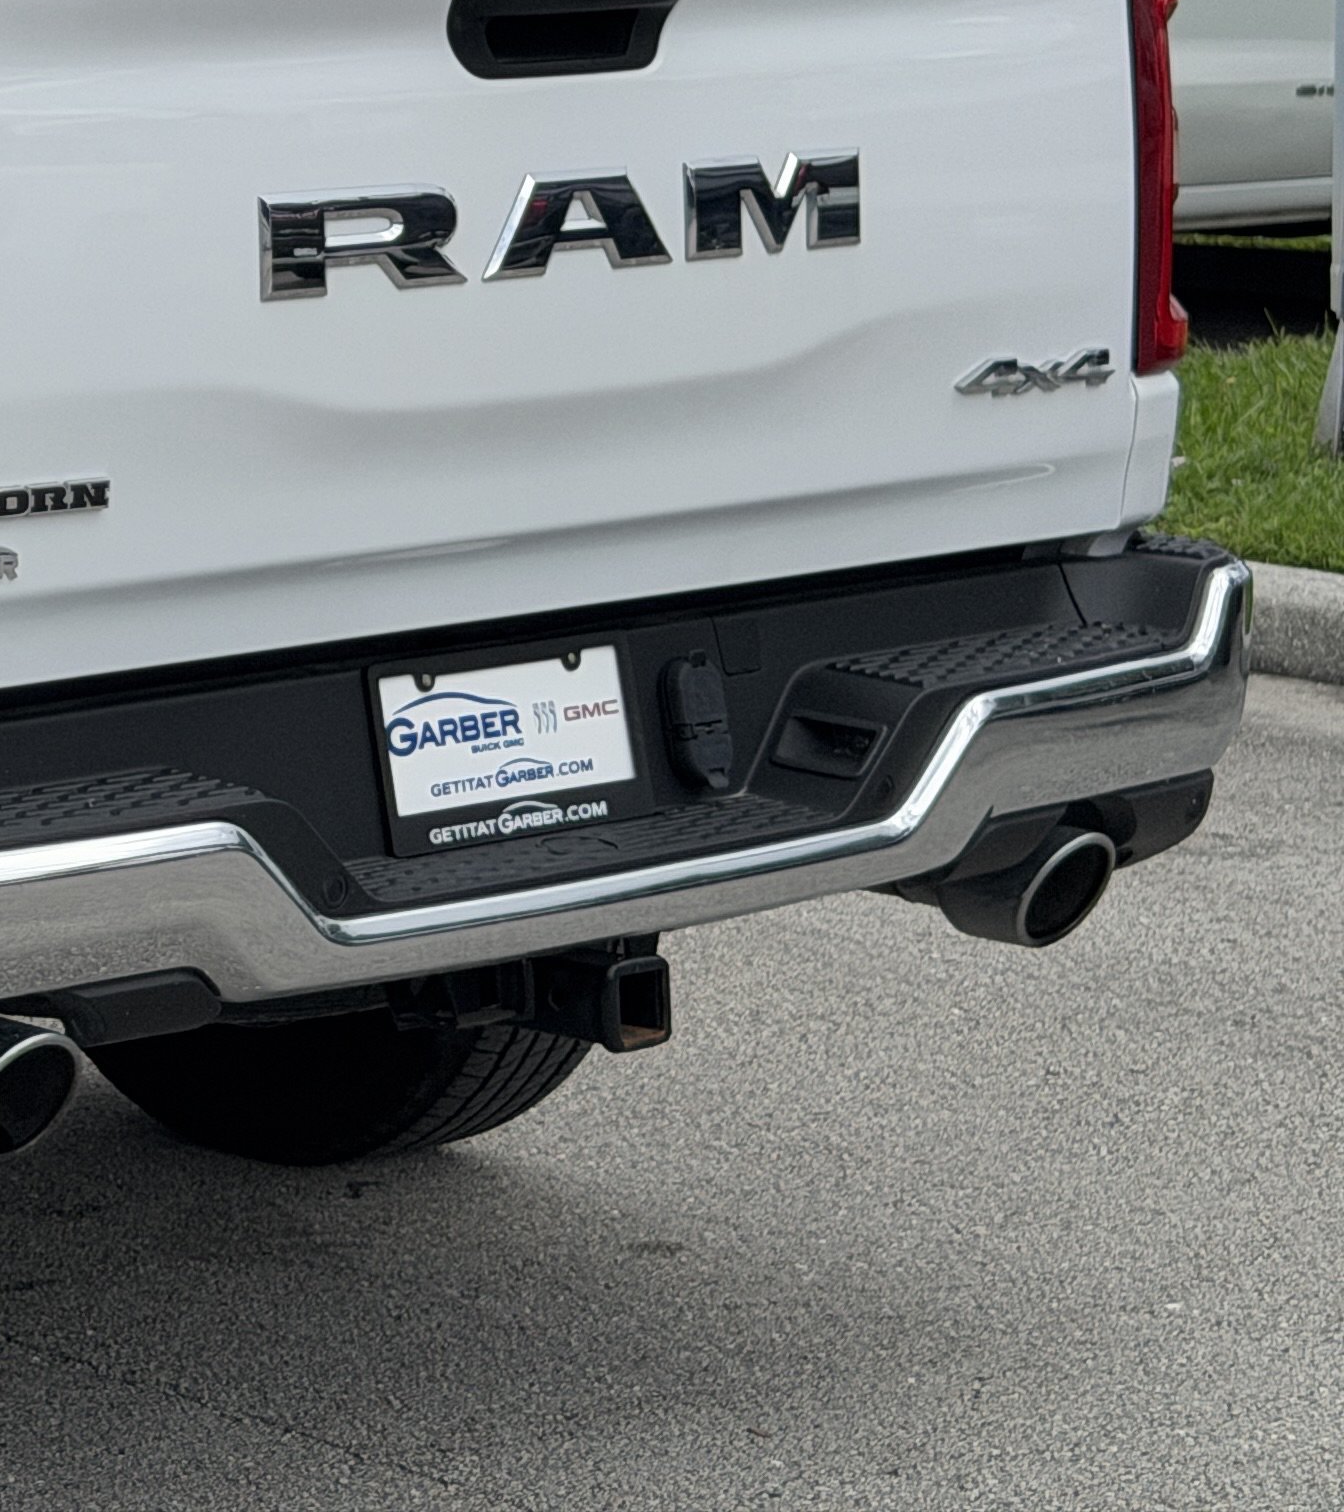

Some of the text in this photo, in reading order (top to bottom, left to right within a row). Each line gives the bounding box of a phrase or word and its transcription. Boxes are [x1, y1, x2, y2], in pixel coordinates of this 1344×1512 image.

[258, 148, 861, 301] RAM
[564, 700, 619, 721] GMC
[386, 709, 521, 756] GARBER
[471, 741, 501, 754] BUICK
[431, 759, 593, 797] GETITATGARBER.COM
[429, 801, 607, 844] GETITATGARBER.COM
